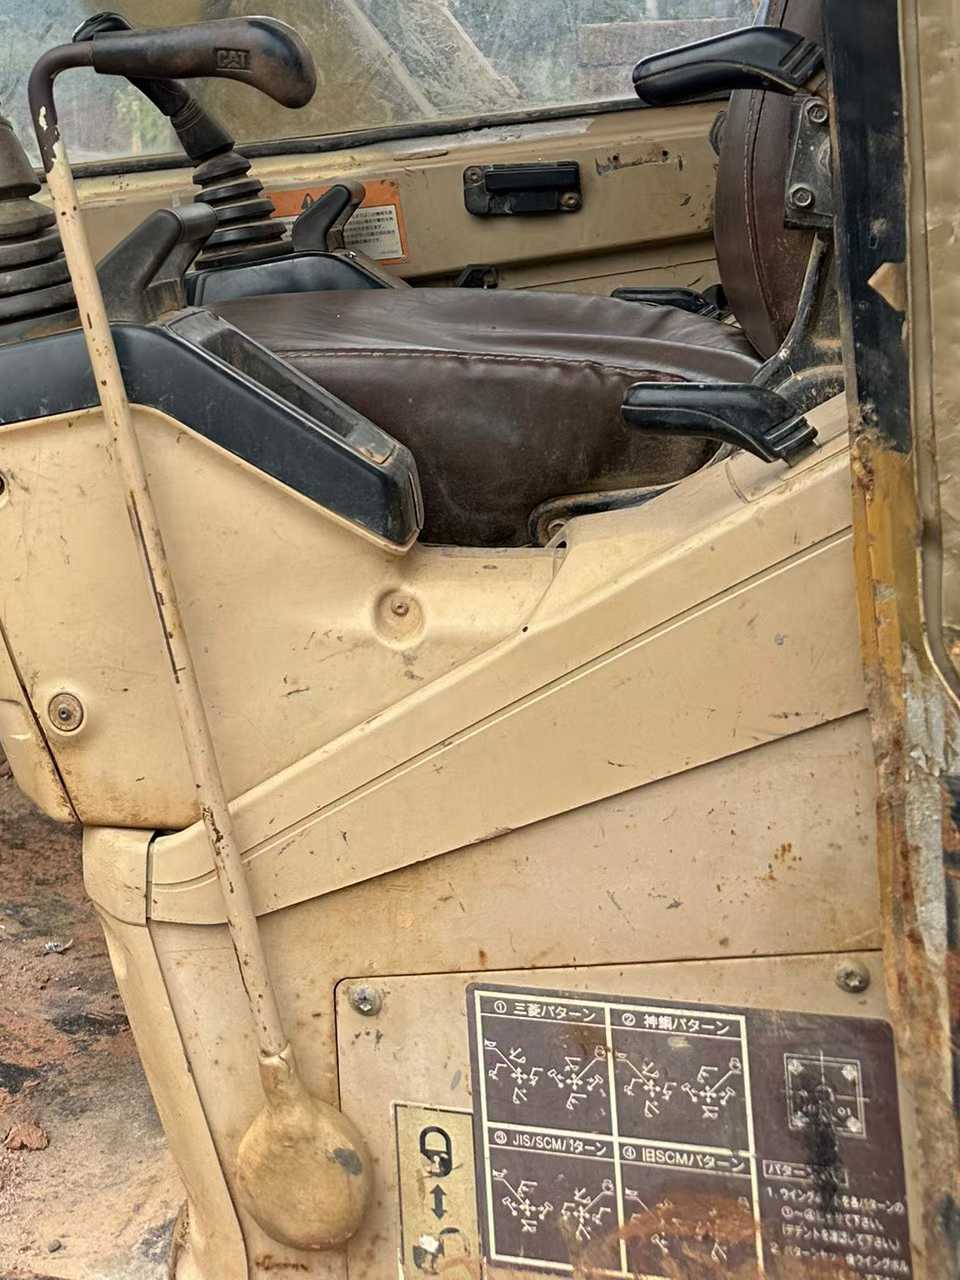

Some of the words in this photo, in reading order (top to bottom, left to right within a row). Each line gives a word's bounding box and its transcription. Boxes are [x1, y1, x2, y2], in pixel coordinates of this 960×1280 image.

[216, 49, 250, 69] CAT
[513, 1002, 596, 1022] 三菱パターン
